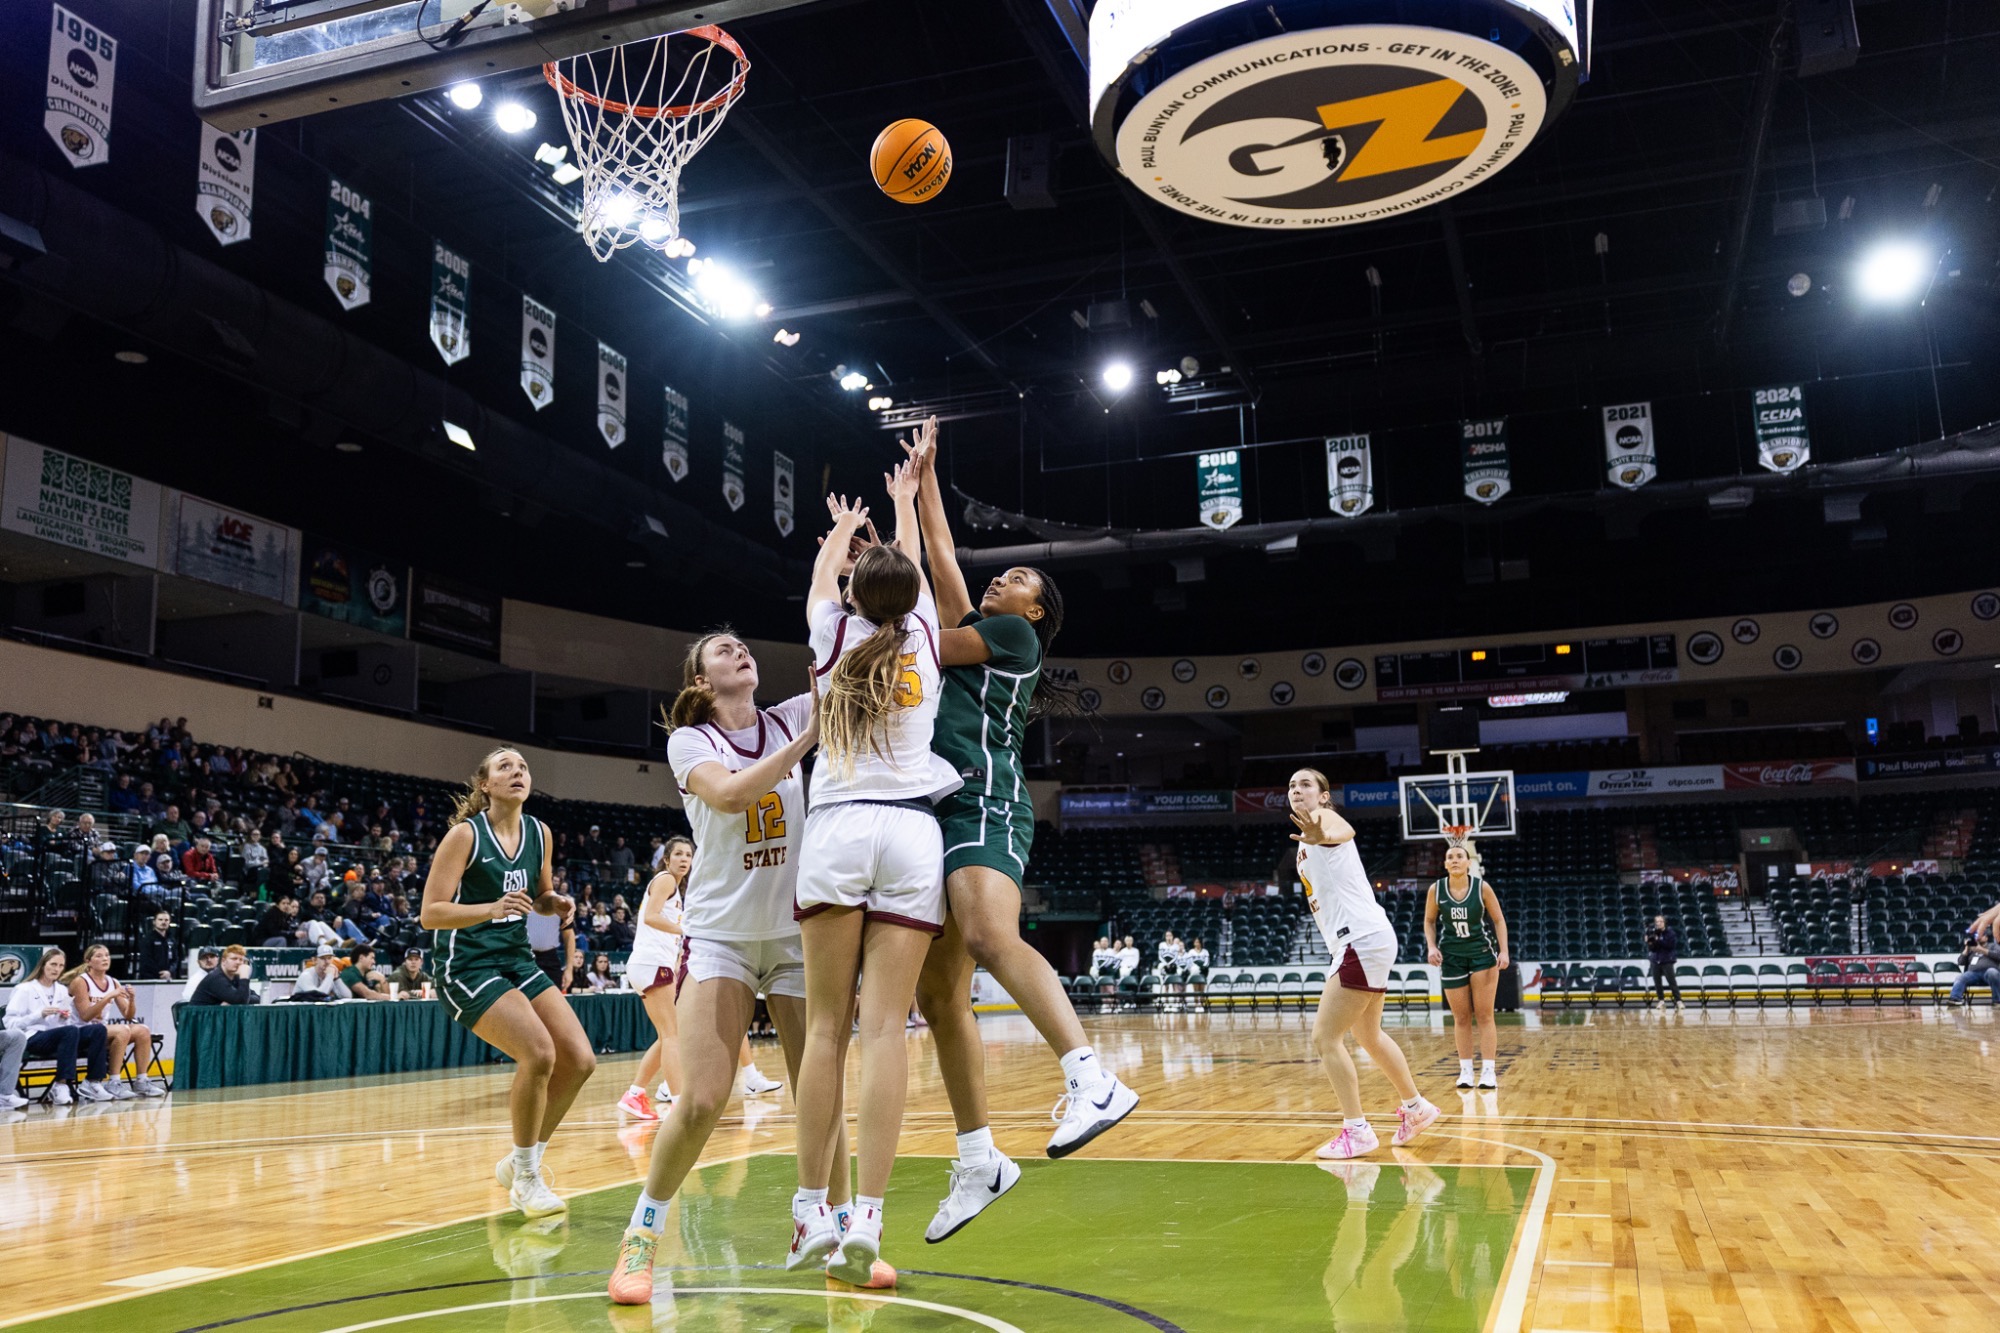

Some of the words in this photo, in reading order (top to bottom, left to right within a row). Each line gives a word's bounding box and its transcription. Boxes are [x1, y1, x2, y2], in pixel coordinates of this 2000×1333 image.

[54, 10, 113, 61] 1995
[1388, 43, 1430, 56] GET
[1430, 48, 1456, 61] IN
[69, 60, 97, 84] NCAA
[1182, 43, 1370, 100] COMMUNICATIONS
[1456, 55, 1490, 74] THE
[51, 75, 98, 106] Division
[1485, 69, 1522, 99] ZONE!
[47, 97, 110, 140] CHAMPIONS
[1143, 100, 1185, 143] BUNYAN
[1504, 112, 1525, 140] PAUL
[903, 142, 936, 179] NCAA
[1141, 145, 1157, 168] PAUL
[1463, 141, 1515, 180] BUNYAN
[202, 162, 240, 189] Division
[913, 156, 951, 197] Wilson
[199, 182, 251, 219] CHAMPIONS
[330, 179, 370, 220] 2004
[1158, 184, 1198, 206] ZONE!
[1302, 180, 1464, 224] COMMUNICATIONS
[1195, 203, 1227, 218] THE
[1230, 212, 1249, 222] IN
[1252, 217, 1285, 225] GET
[435, 244, 469, 279] 2005
[1755, 386, 1801, 405] 2024
[1607, 405, 1648, 421] 2021
[1760, 407, 1802, 422] CCHA
[1463, 421, 1504, 438] 2017
[1618, 435, 1642, 445] NCAA
[1758, 426, 1806, 435] Conference
[1329, 438, 1366, 453] 2010
[1759, 436, 1809, 450] CHAMPIONS
[1199, 451, 1238, 468] 2010
[1465, 468, 1509, 483] CHAMPIONS
[40, 488, 98, 516] NATURE'S
[101, 507, 129, 526] EDGE
[39, 503, 83, 523] GARDEN
[89, 518, 129, 536] CENTER
[217, 516, 254, 542] ACE
[16, 510, 84, 536] LANDSCAPING
[95, 533, 145, 554] IRRIGATION
[35, 526, 63, 541] LAWN
[66, 535, 88, 548] CARE
[100, 544, 129, 558] SNOW
[1382, 689, 1405, 698] CHEER
[1406, 688, 1419, 696] FOR
[1420, 687, 1435, 696] THE
[1436, 686, 1456, 695] TEAM
[1457, 684, 1488, 693] WITHOUT
[1489, 682, 1515, 691] LOSING
[1517, 681, 1537, 689] YOUR
[1760, 763, 1813, 784] Coca-Cola
[1878, 761, 1901, 772] Paul
[1902, 759, 1941, 770] Bunyan
[1350, 791, 1389, 802] Power
[1516, 784, 1556, 795] count
[1559, 782, 1577, 792] on.
[1668, 777, 1715, 788] otpco.com
[1154, 795, 1184, 805] YOUR
[1186, 795, 1219, 804] LOCAL
[745, 791, 786, 844] 12
[743, 846, 787, 870] STATE
[503, 868, 528, 892] BSU
[1451, 906, 1468, 920] BSU
[1452, 921, 1470, 938] 10
